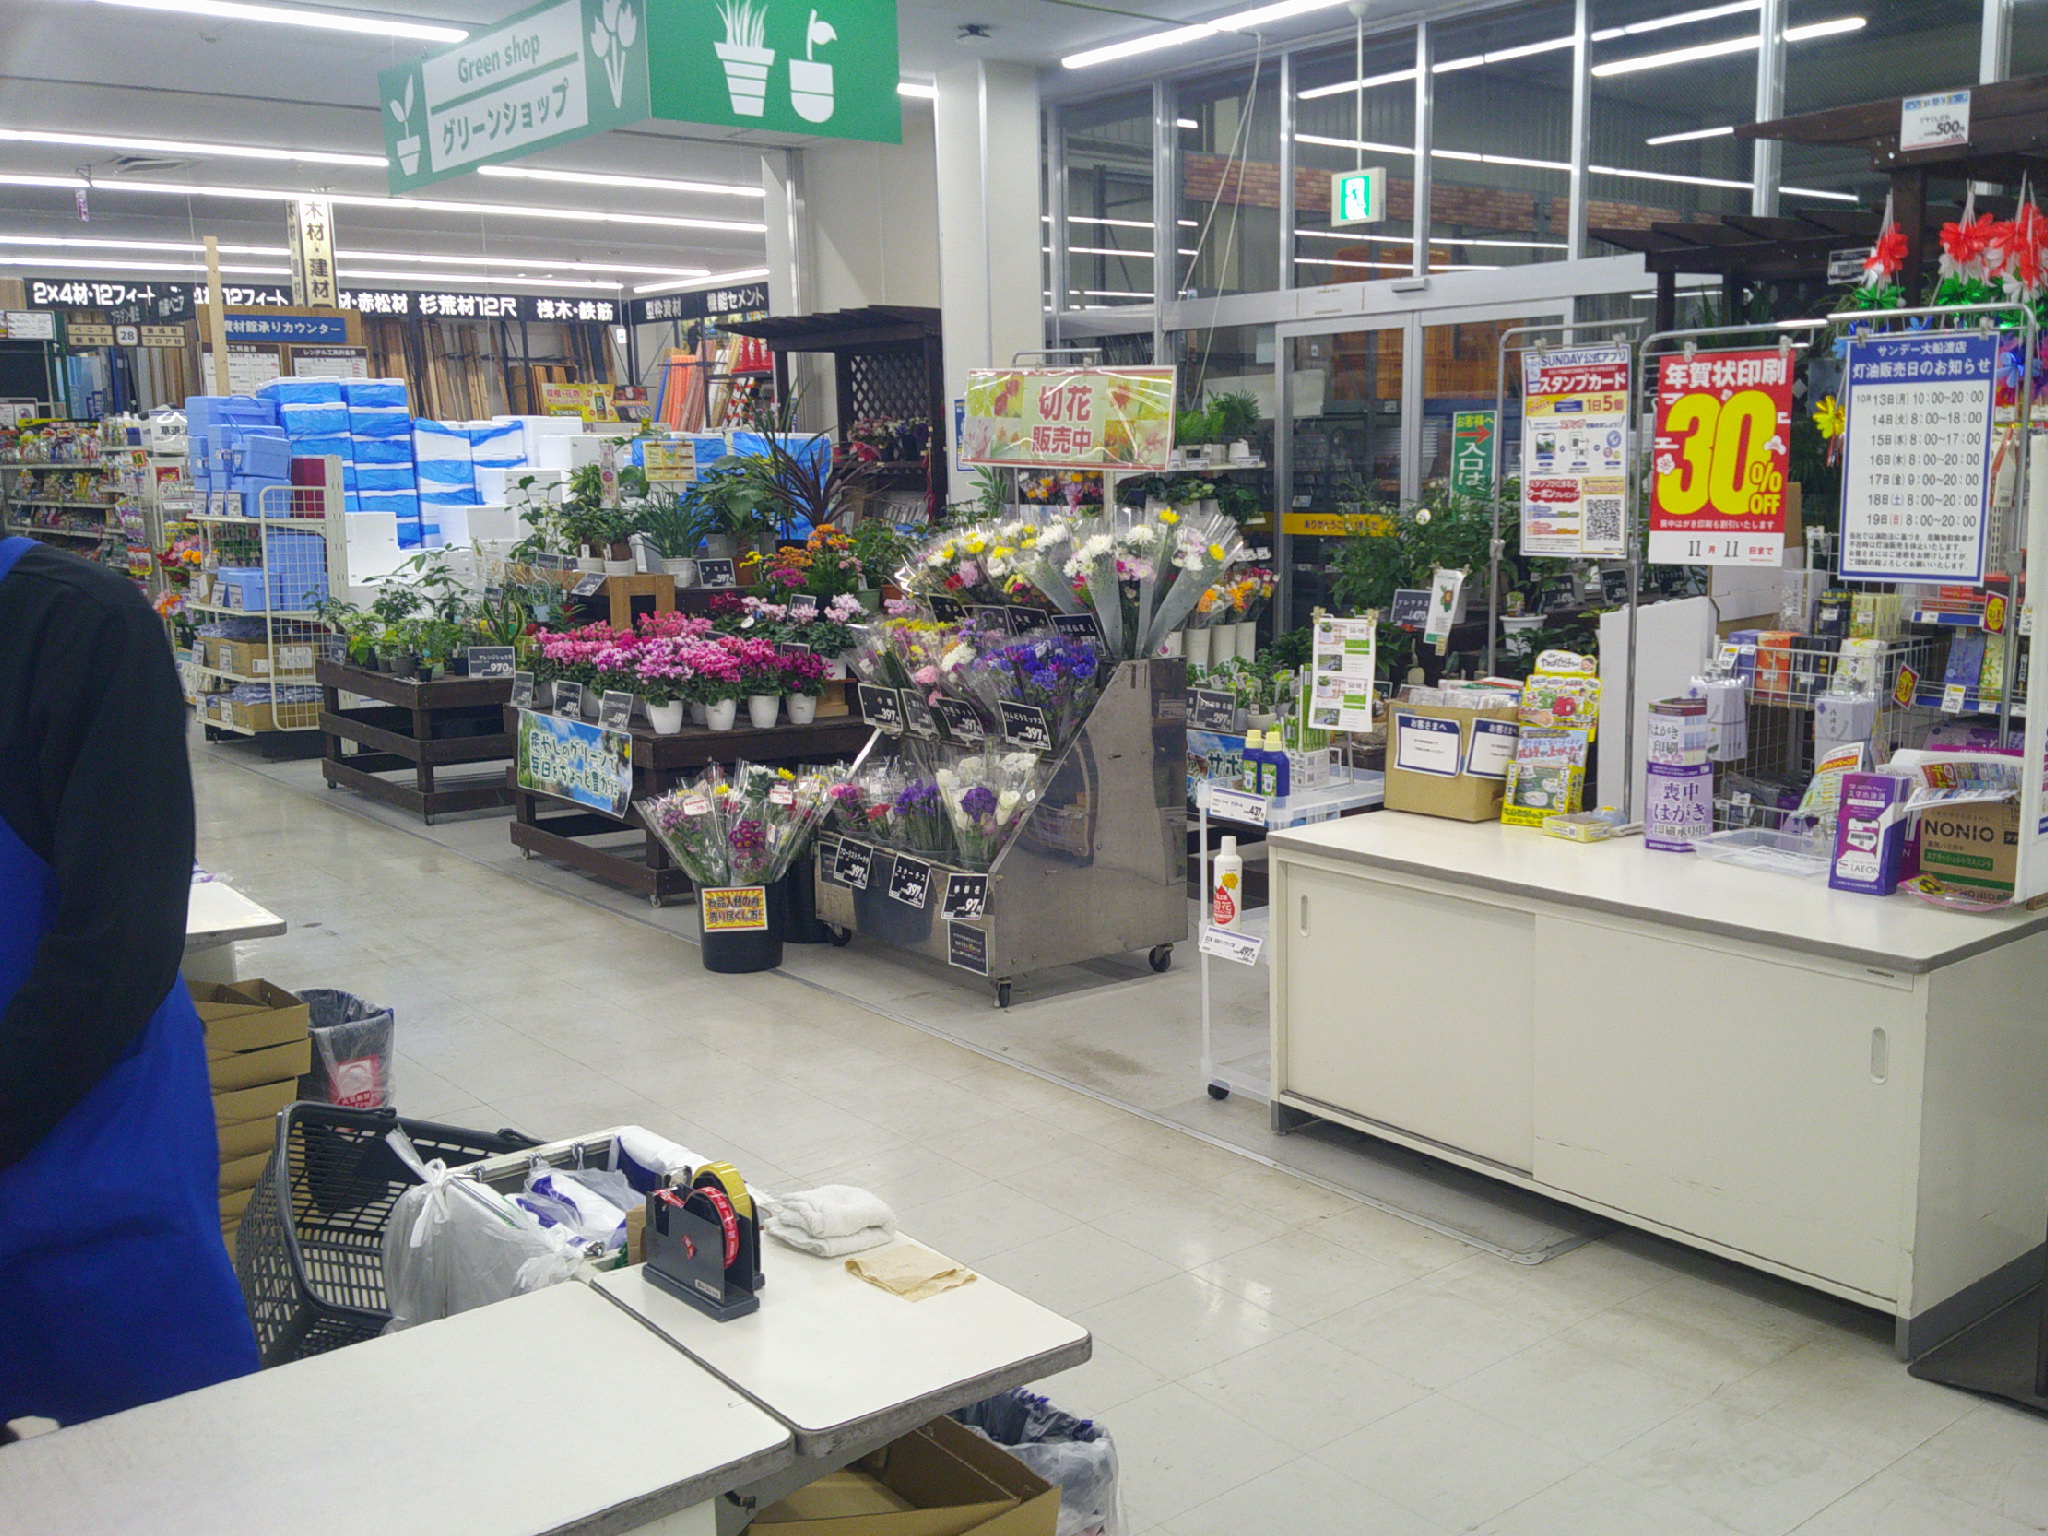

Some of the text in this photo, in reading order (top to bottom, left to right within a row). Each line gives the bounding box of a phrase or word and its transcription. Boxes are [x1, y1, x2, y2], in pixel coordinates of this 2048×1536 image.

[457, 34, 540, 84] Green shop
[442, 77, 569, 156] グリーンショップ
[305, 200, 330, 298] 木材・建材
[419, 293, 518, 318] 杉荒材12尺
[706, 286, 765, 313] 機能セメント
[120, 331, 135, 341] 28
[1664, 357, 1788, 390] 年賀状印刷
[1851, 357, 1992, 380] 灯油販売日のお知らせ
[1540, 372, 1627, 394] スタンプカード
[1037, 385, 1093, 422] 切花
[1031, 425, 1093, 455] 販売中
[1657, 389, 1778, 516] 30
[1749, 493, 1781, 516] OFF
[1688, 540, 1702, 557] 11
[1723, 541, 1740, 558] 11
[1664, 782, 1699, 802] 喪中
[1653, 802, 1706, 823] はがき
[1924, 819, 1995, 843] NONIO
